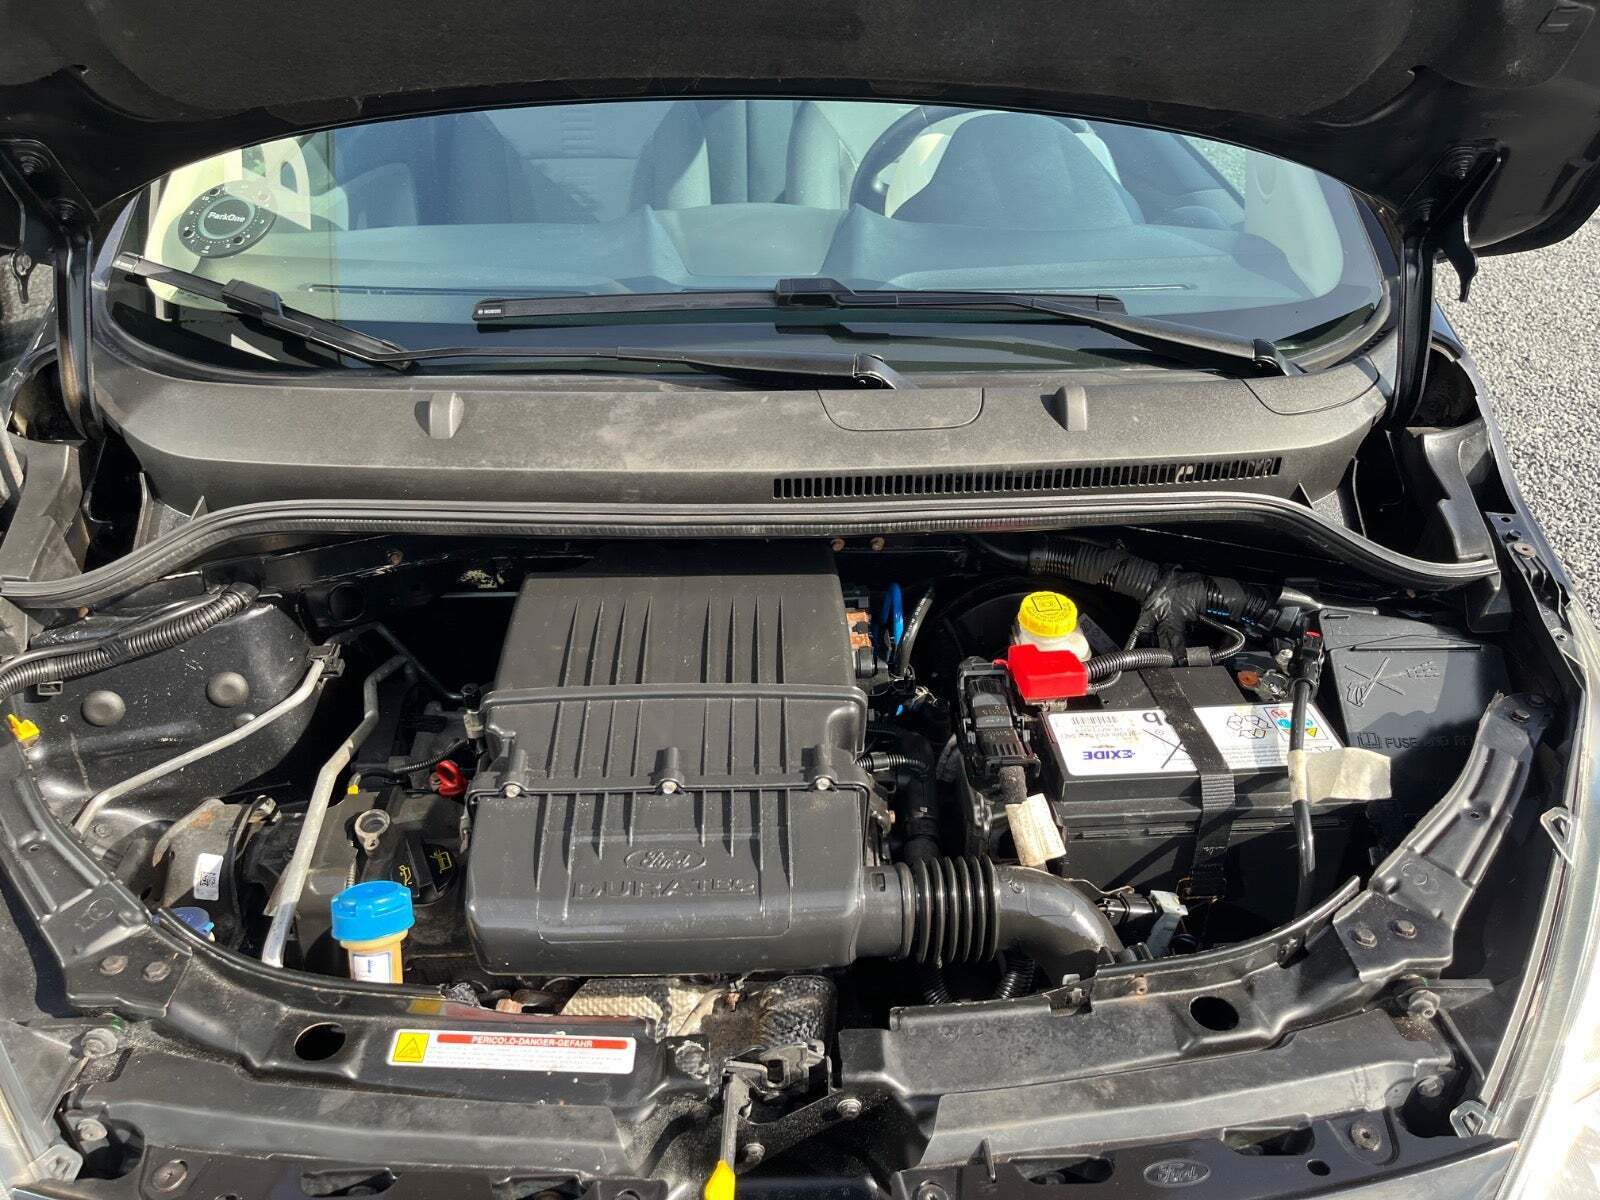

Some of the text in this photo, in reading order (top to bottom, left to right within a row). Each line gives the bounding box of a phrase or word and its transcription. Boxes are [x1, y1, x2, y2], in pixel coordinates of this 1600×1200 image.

[207, 211, 246, 223] ParkOne
[1082, 749, 1136, 761] EXIDE
[471, 1034, 593, 1049] PERICOLO-DANGER-GEFAHR
